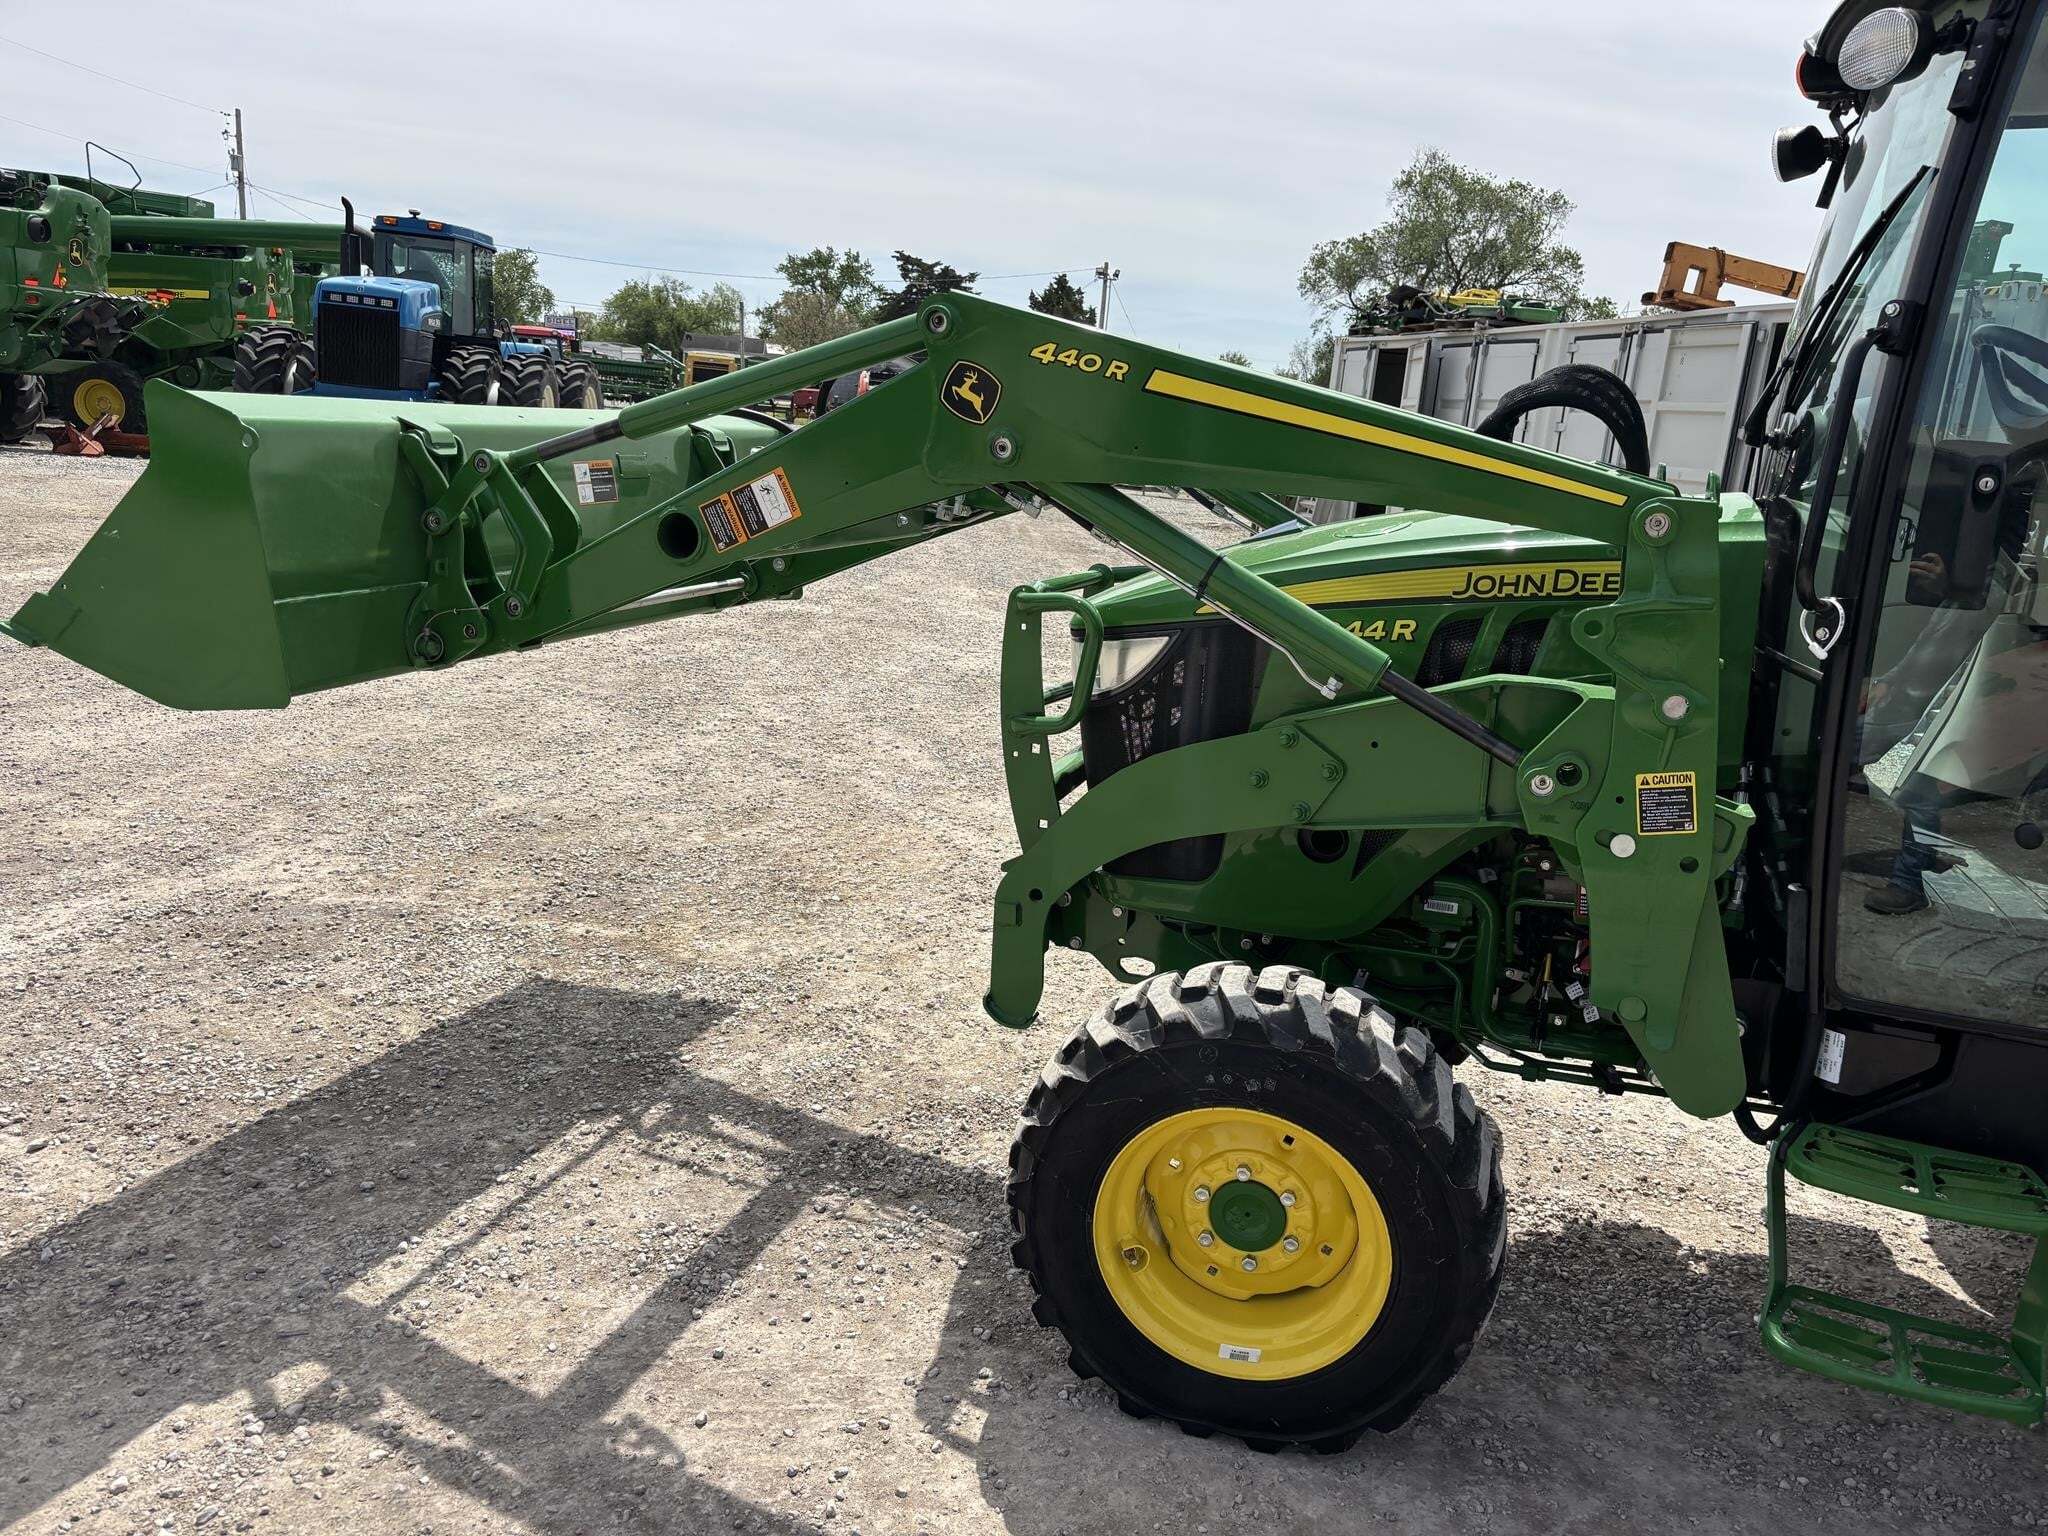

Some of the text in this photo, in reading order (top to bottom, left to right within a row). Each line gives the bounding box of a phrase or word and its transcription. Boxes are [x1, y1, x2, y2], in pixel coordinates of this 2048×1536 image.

[780, 481, 798, 513] WARNING
[727, 507, 744, 538] WARNING
[1452, 568, 1621, 597] JOHN DEE
[1652, 773, 1692, 786] CAUTION
